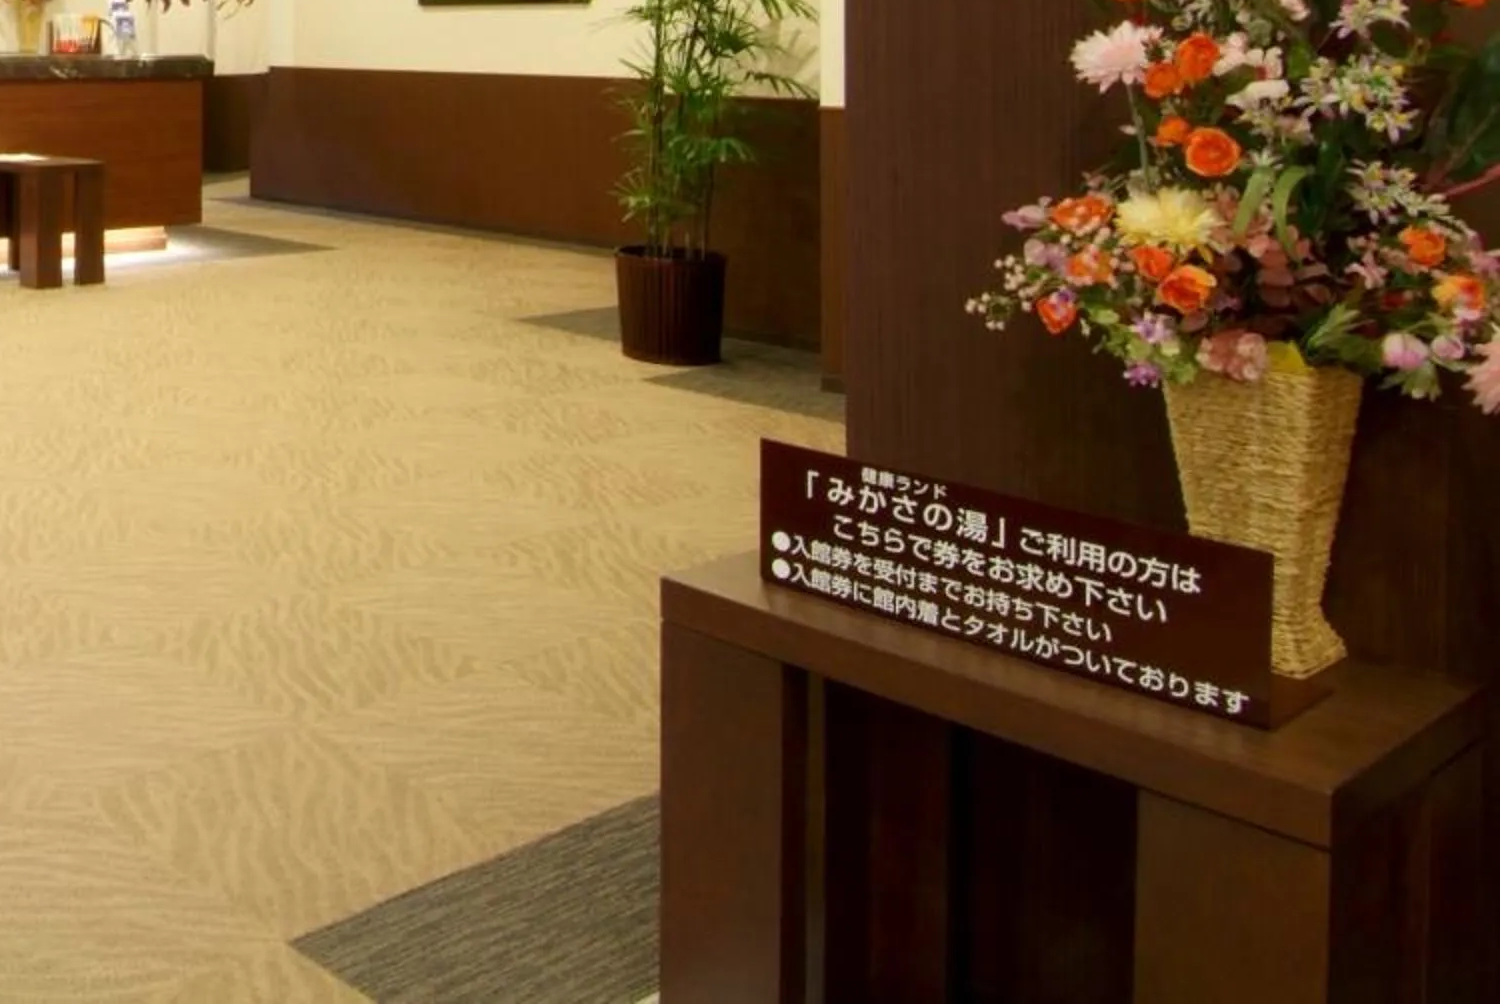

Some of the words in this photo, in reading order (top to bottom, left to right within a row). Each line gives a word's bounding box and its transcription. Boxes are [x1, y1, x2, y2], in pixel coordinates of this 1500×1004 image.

[805, 469, 1203, 595] 「みかさの湯」ご利用の方は
[860, 465, 948, 499] 健康ランド
[832, 513, 1168, 624] こちらで券をお求め下さい
